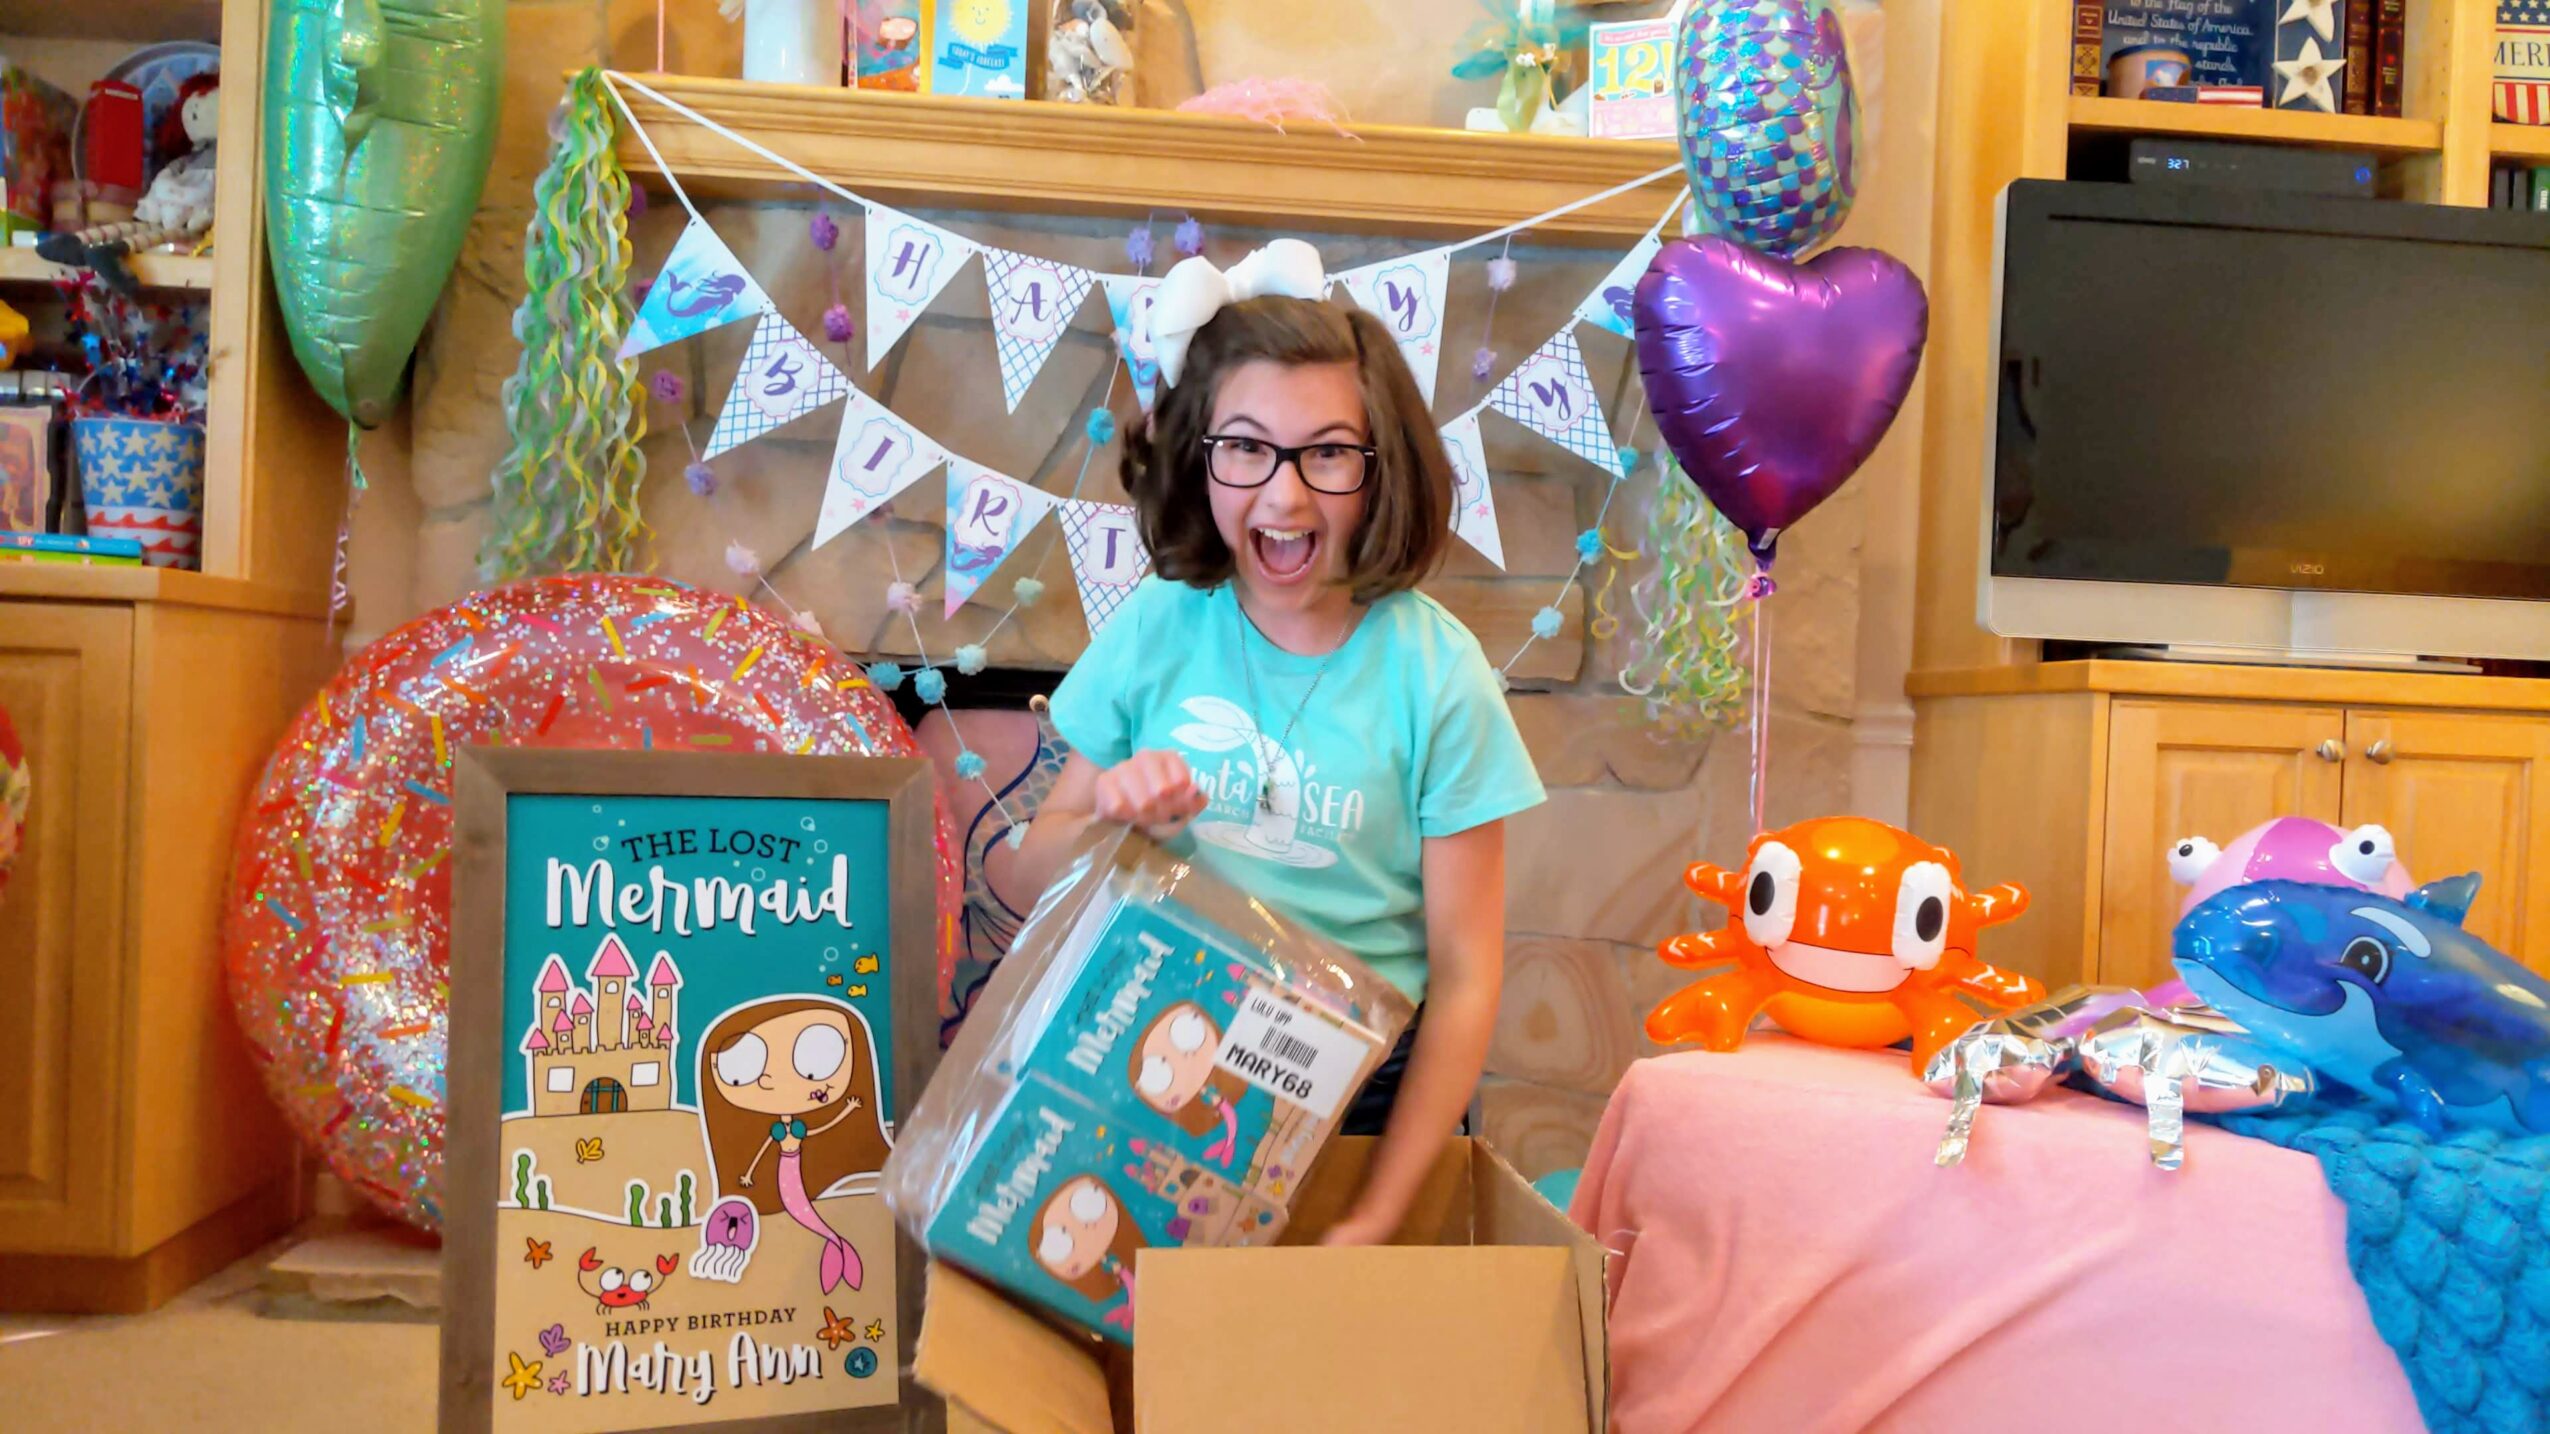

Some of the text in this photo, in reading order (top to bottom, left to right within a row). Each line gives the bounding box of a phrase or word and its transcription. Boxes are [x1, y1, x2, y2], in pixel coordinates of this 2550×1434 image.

[2108, 9, 2148, 28] United
[2151, 14, 2186, 31] States
[2188, 19, 2201, 35] of
[2123, 31, 2150, 45] and
[2192, 37, 2239, 58] republic
[1596, 41, 1674, 93] 12!
[2291, 564, 2325, 575] VIZIO
[1303, 781, 1365, 831] SEA
[621, 828, 801, 864] THE LOST
[546, 853, 854, 936] Mermaid
[1225, 1043, 1313, 1099] MARY68
[605, 1307, 797, 1338] HAPPY BIRTHDAY
[576, 1331, 823, 1407] Mary Ann
